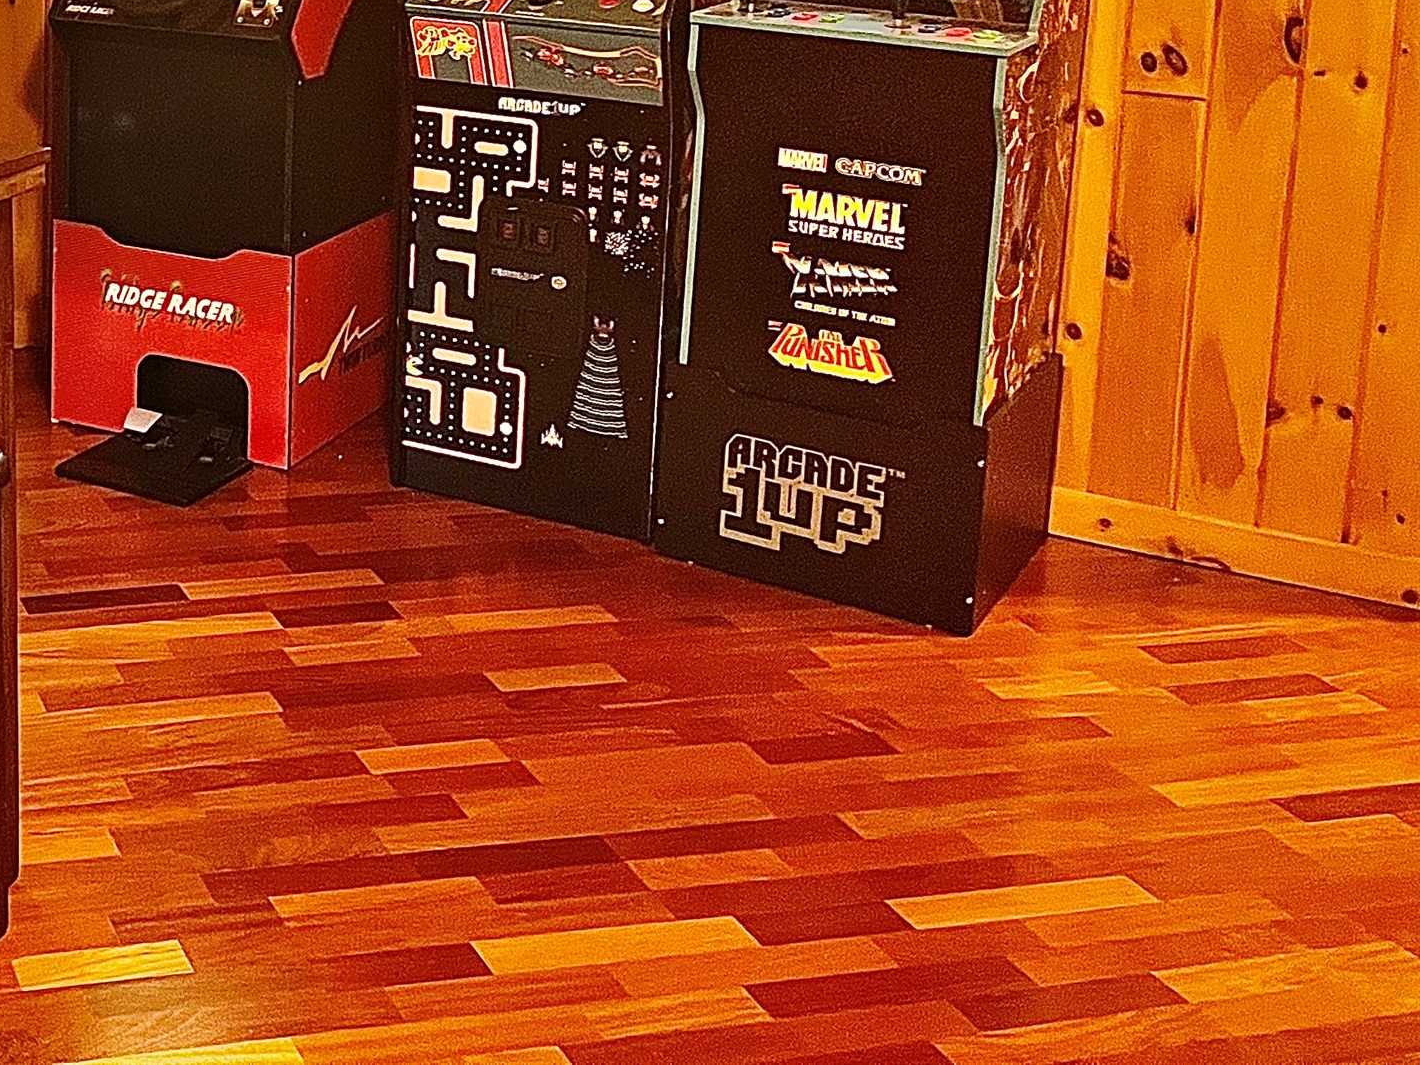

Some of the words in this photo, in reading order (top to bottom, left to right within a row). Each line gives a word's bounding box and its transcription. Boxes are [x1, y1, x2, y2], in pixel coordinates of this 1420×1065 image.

[778, 147, 828, 173] MARVEL
[835, 157, 923, 186] CAPCOM
[788, 219, 839, 239] SUPER
[842, 227, 906, 250] HEROES
[790, 188, 906, 235] MARVEL
[105, 282, 167, 310] RIDGE
[166, 293, 236, 323] RACER
[769, 323, 893, 381] PUNISHER
[726, 434, 886, 507] ARCADE
[720, 465, 881, 554] 1UP
